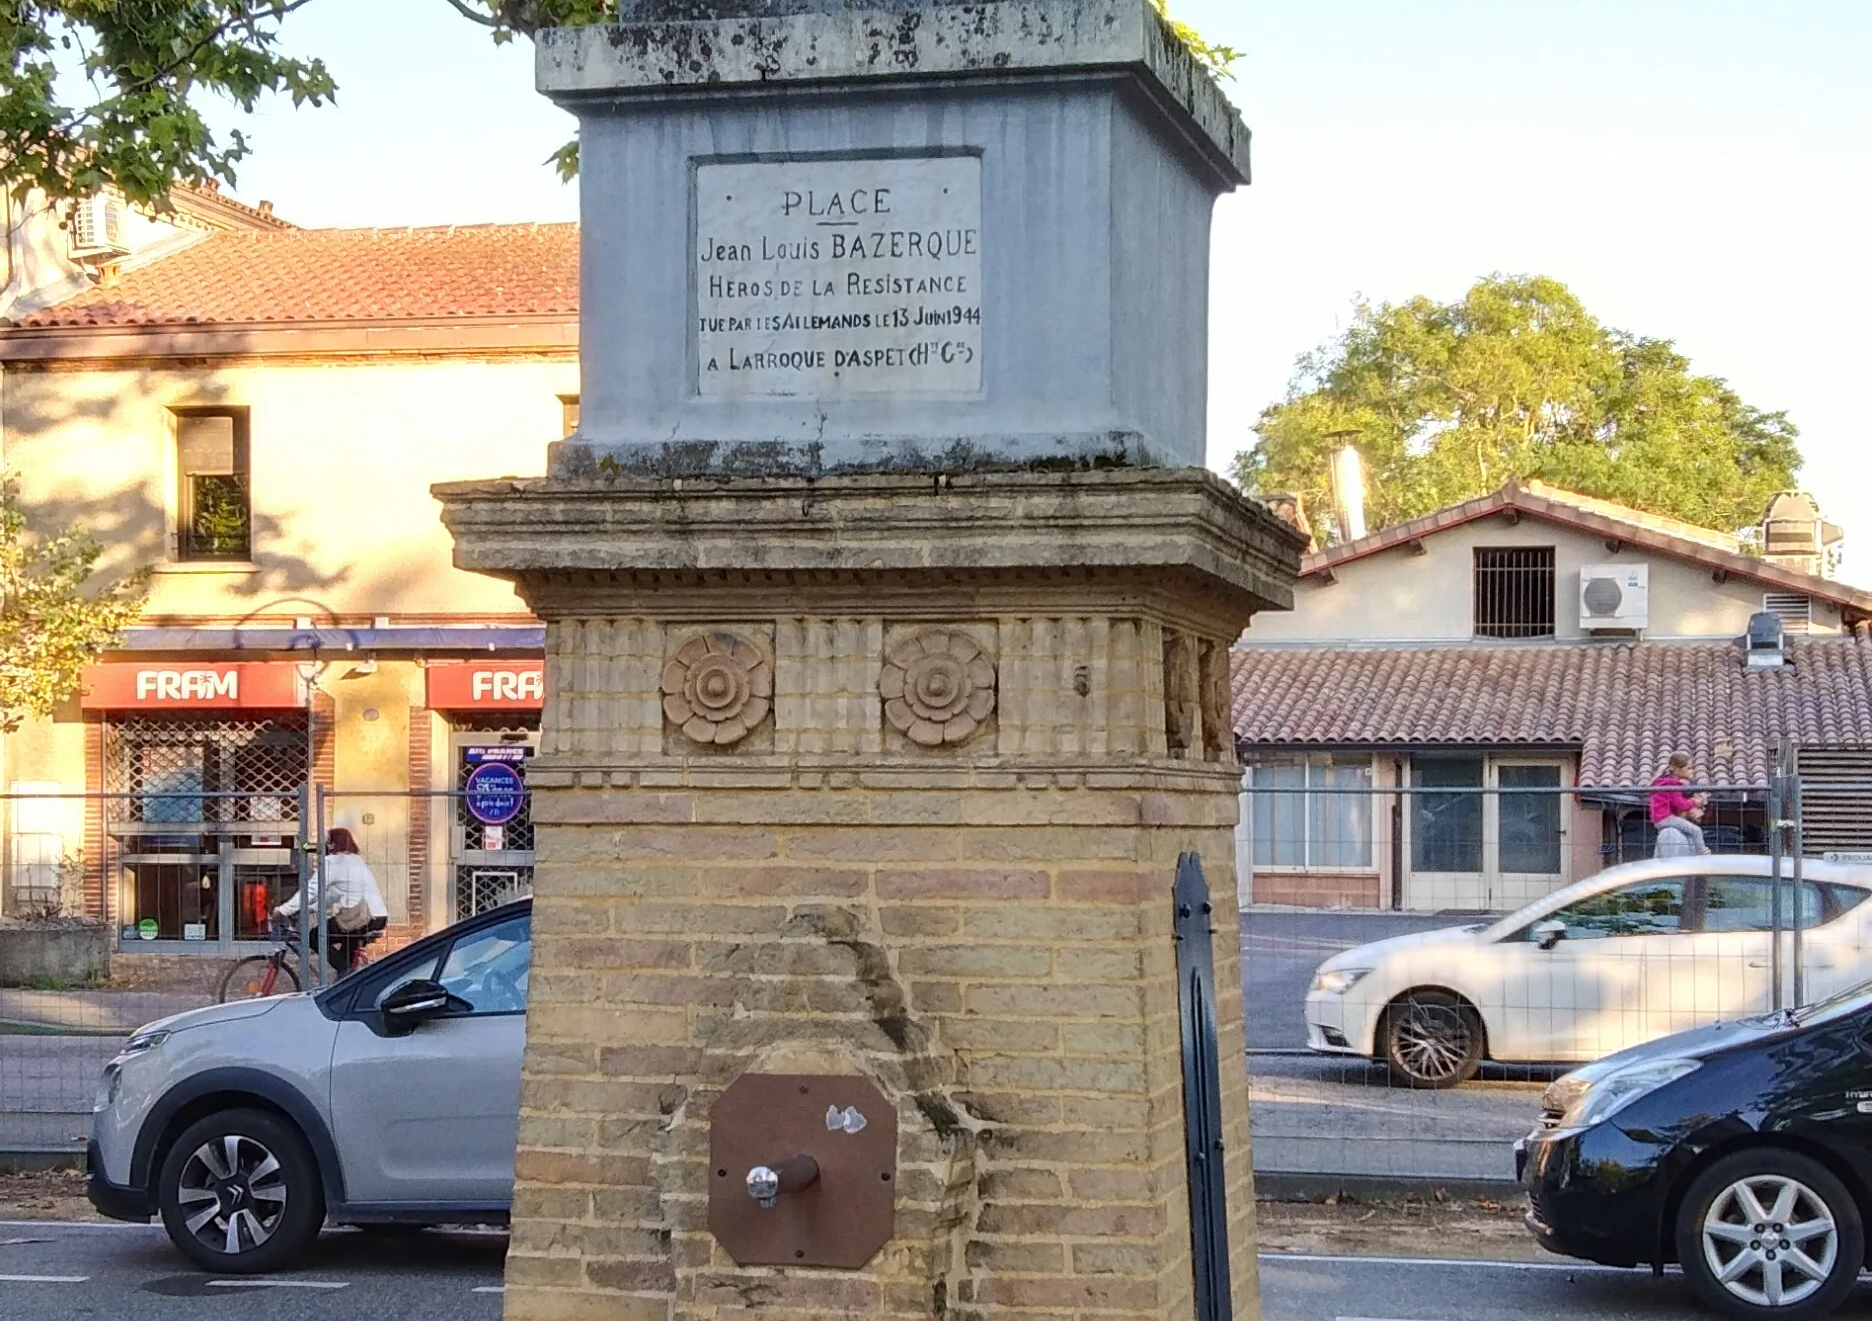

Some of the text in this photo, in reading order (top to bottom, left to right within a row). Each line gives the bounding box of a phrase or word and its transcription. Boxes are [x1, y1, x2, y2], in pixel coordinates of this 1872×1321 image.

[784, 188, 891, 216] PLACE
[701, 229, 977, 262] Jean Louis BAZERQUE
[709, 272, 967, 298] HEROS DE LA RESISTANCE
[699, 317, 725, 332] TUE
[728, 316, 752, 331] PAR
[875, 314, 890, 328] LE
[891, 308, 909, 328] 13
[946, 305, 981, 326] 1944
[707, 357, 719, 372] A
[730, 347, 825, 371] LARROQUE
[136, 670, 239, 700] FRAM
[472, 670, 544, 700] FRA
